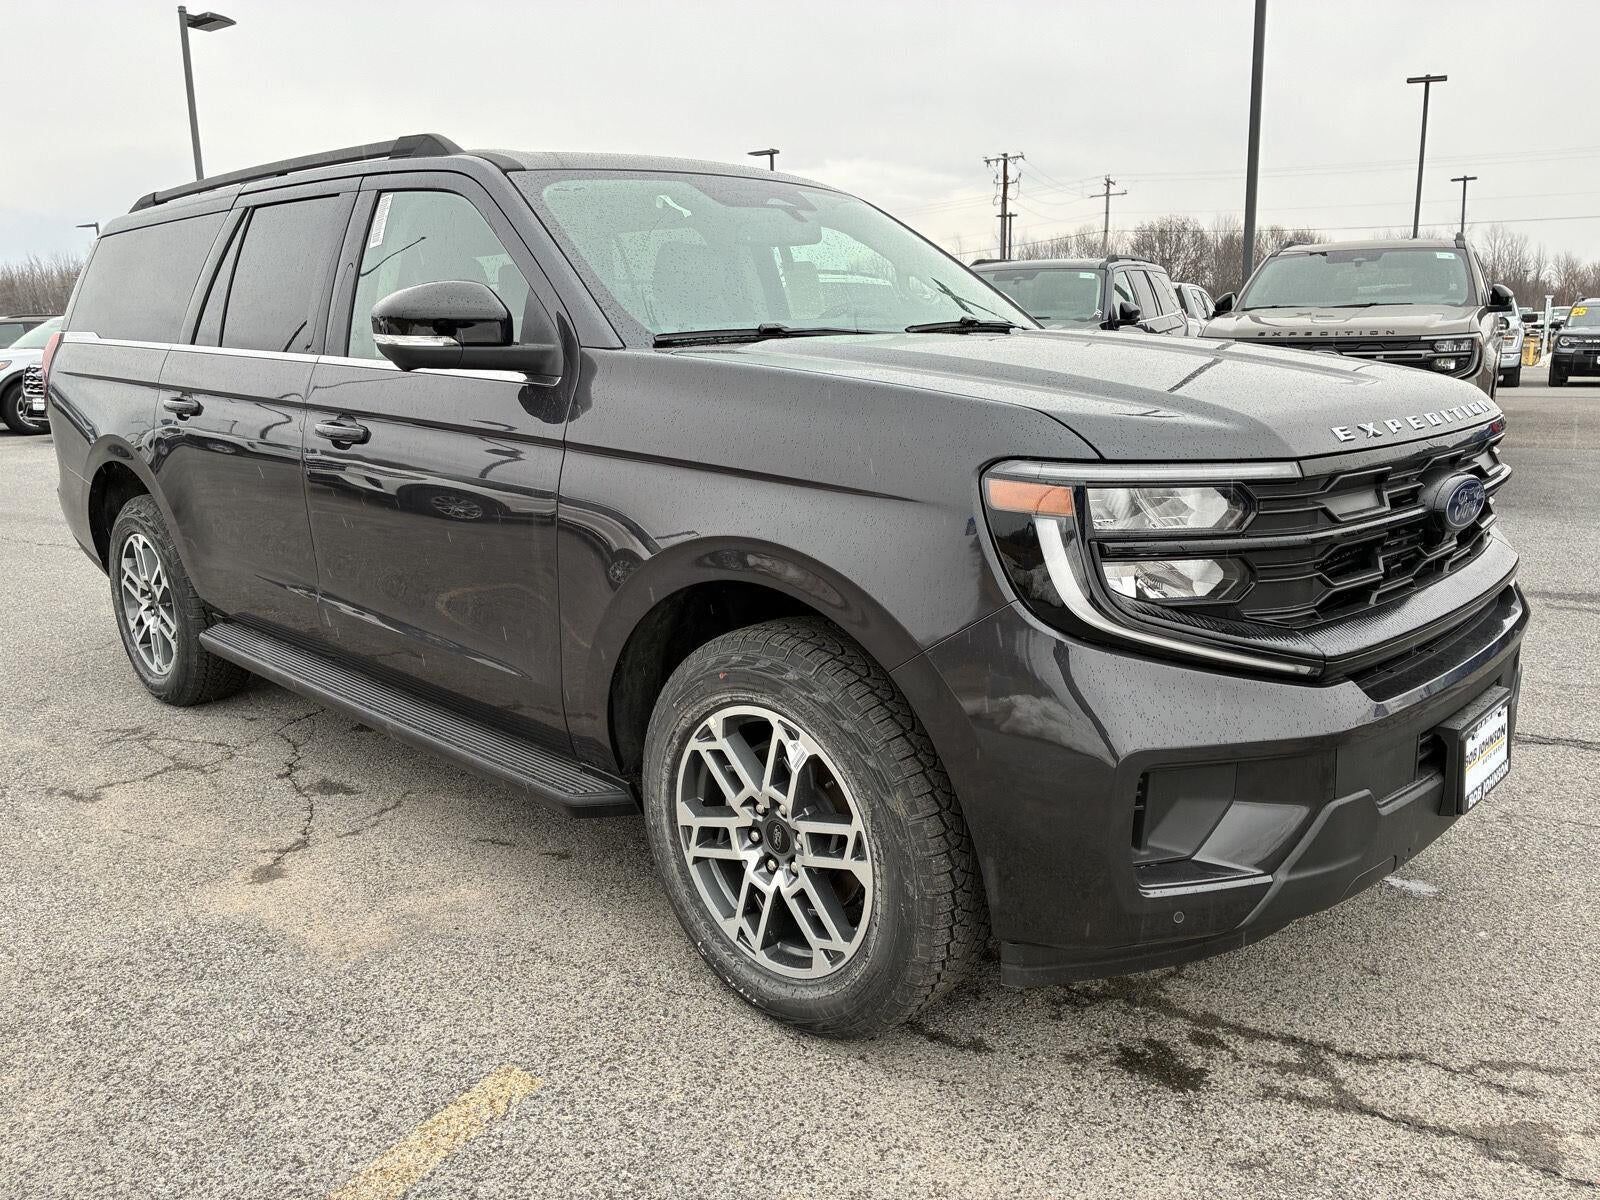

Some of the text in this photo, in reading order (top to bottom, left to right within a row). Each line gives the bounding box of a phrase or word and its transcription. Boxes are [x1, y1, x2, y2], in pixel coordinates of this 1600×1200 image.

[1258, 329, 1396, 337] EXPEDITION
[1331, 399, 1491, 441] EXPEDITION
[1452, 483, 1482, 521] Ford
[1478, 723, 1506, 760] JOHNSON
[1469, 761, 1508, 807] BOB JOHNSON
